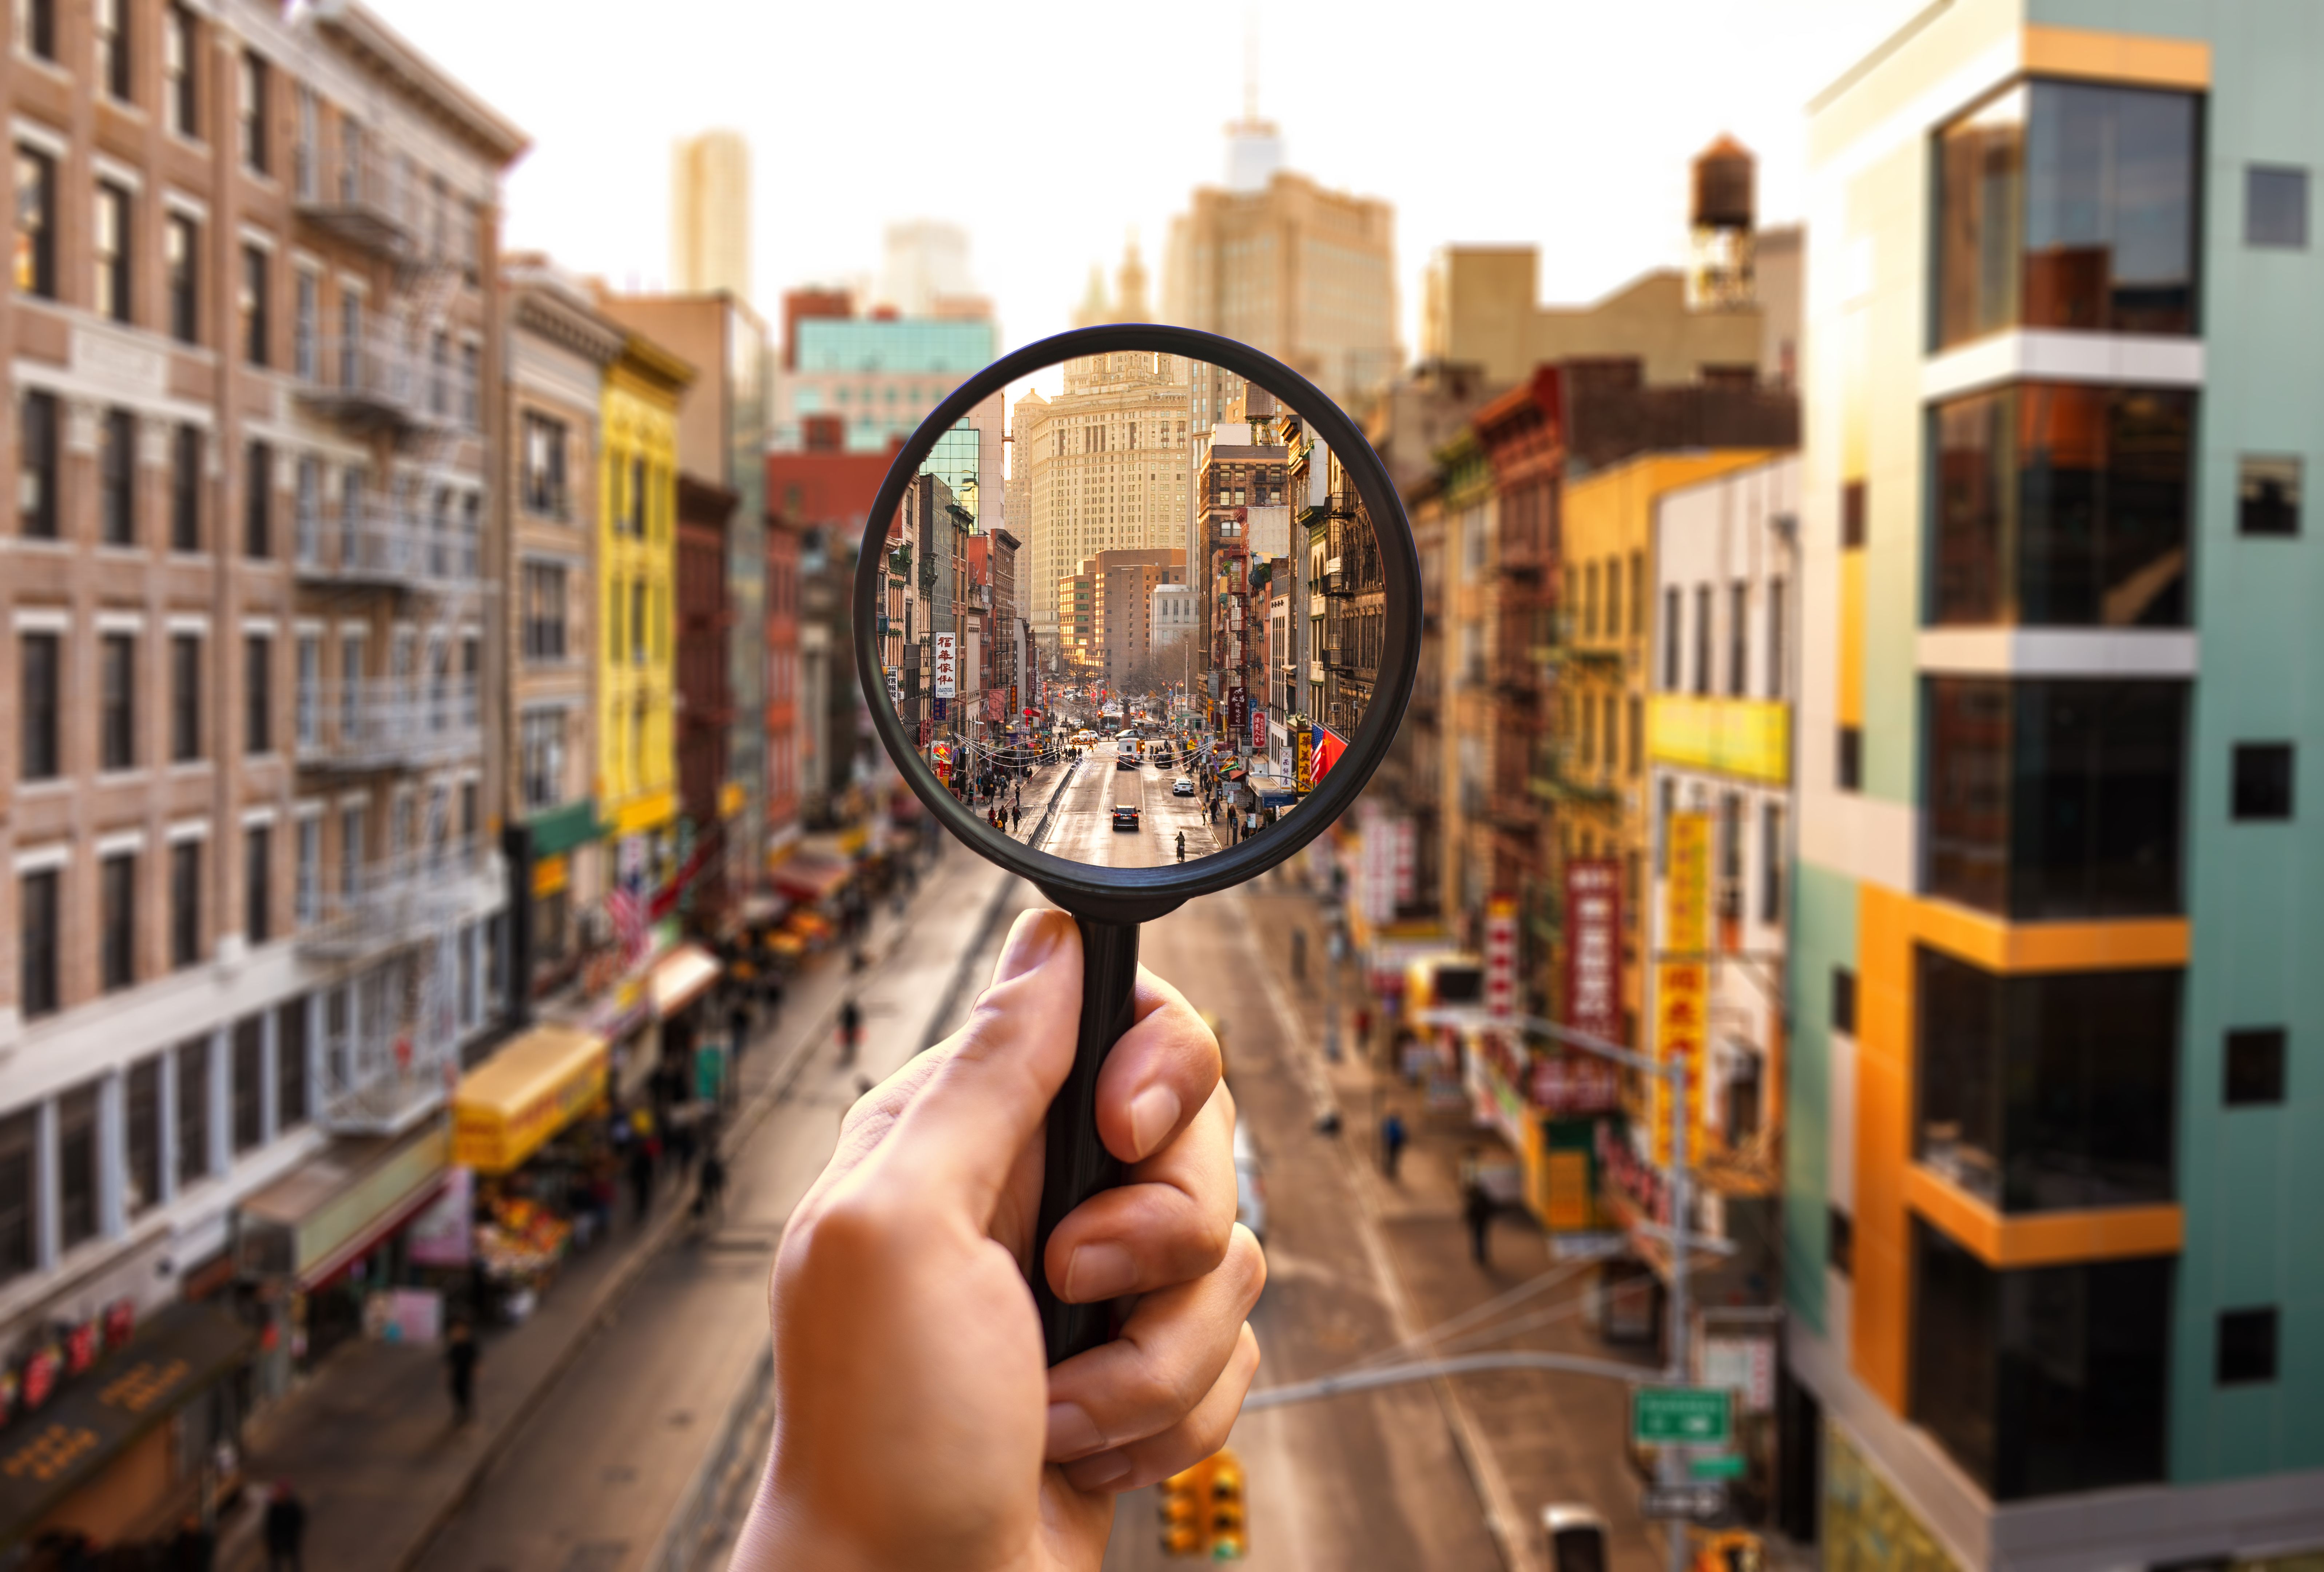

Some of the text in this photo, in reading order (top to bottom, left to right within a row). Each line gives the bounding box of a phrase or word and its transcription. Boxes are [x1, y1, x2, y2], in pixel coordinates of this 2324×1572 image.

[937, 637, 954, 686] 福華傢俬
[1300, 735, 1312, 790] 華美商場
